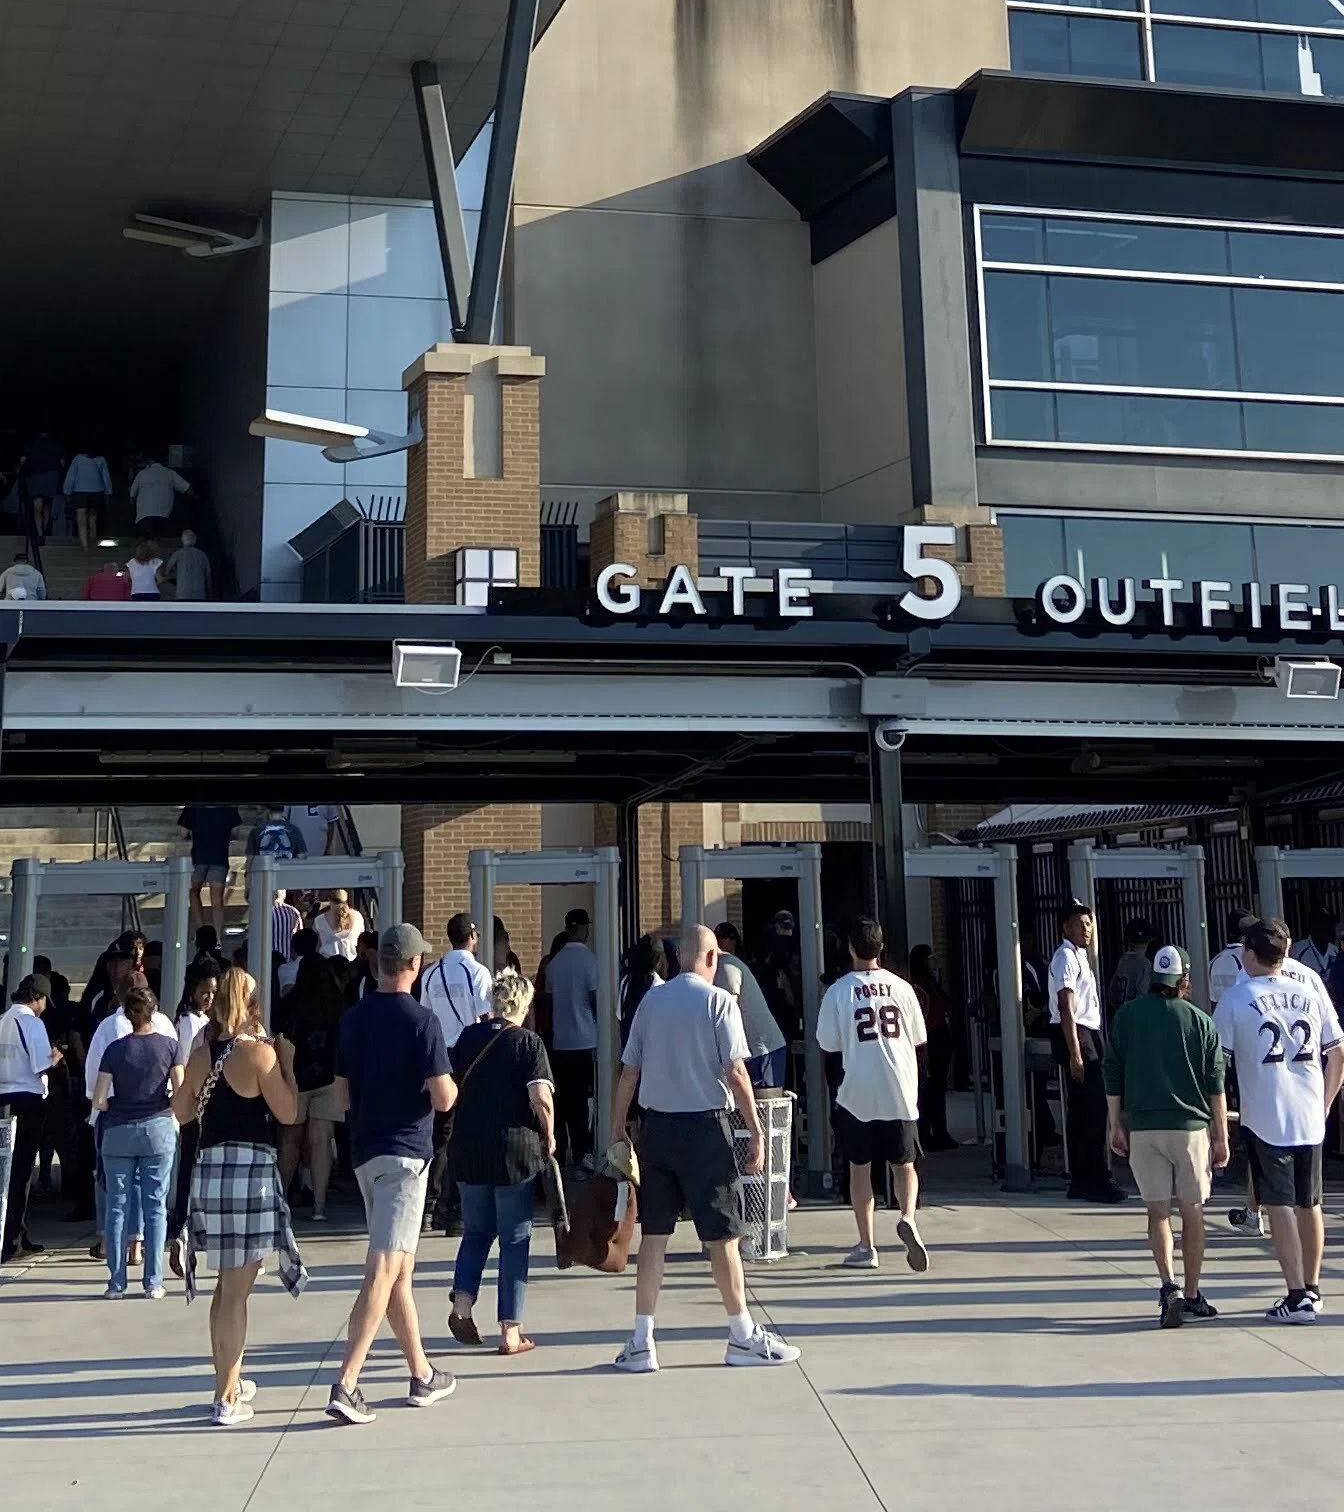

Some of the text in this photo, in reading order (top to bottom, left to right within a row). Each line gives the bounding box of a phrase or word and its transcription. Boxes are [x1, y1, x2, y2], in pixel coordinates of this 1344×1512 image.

[595, 561, 814, 619] GATE
[899, 524, 963, 621] 5
[853, 982, 892, 1001] POSEY
[1248, 992, 1312, 1017] YELICH
[854, 1004, 901, 1043] 28
[1258, 1019, 1314, 1065] 22
